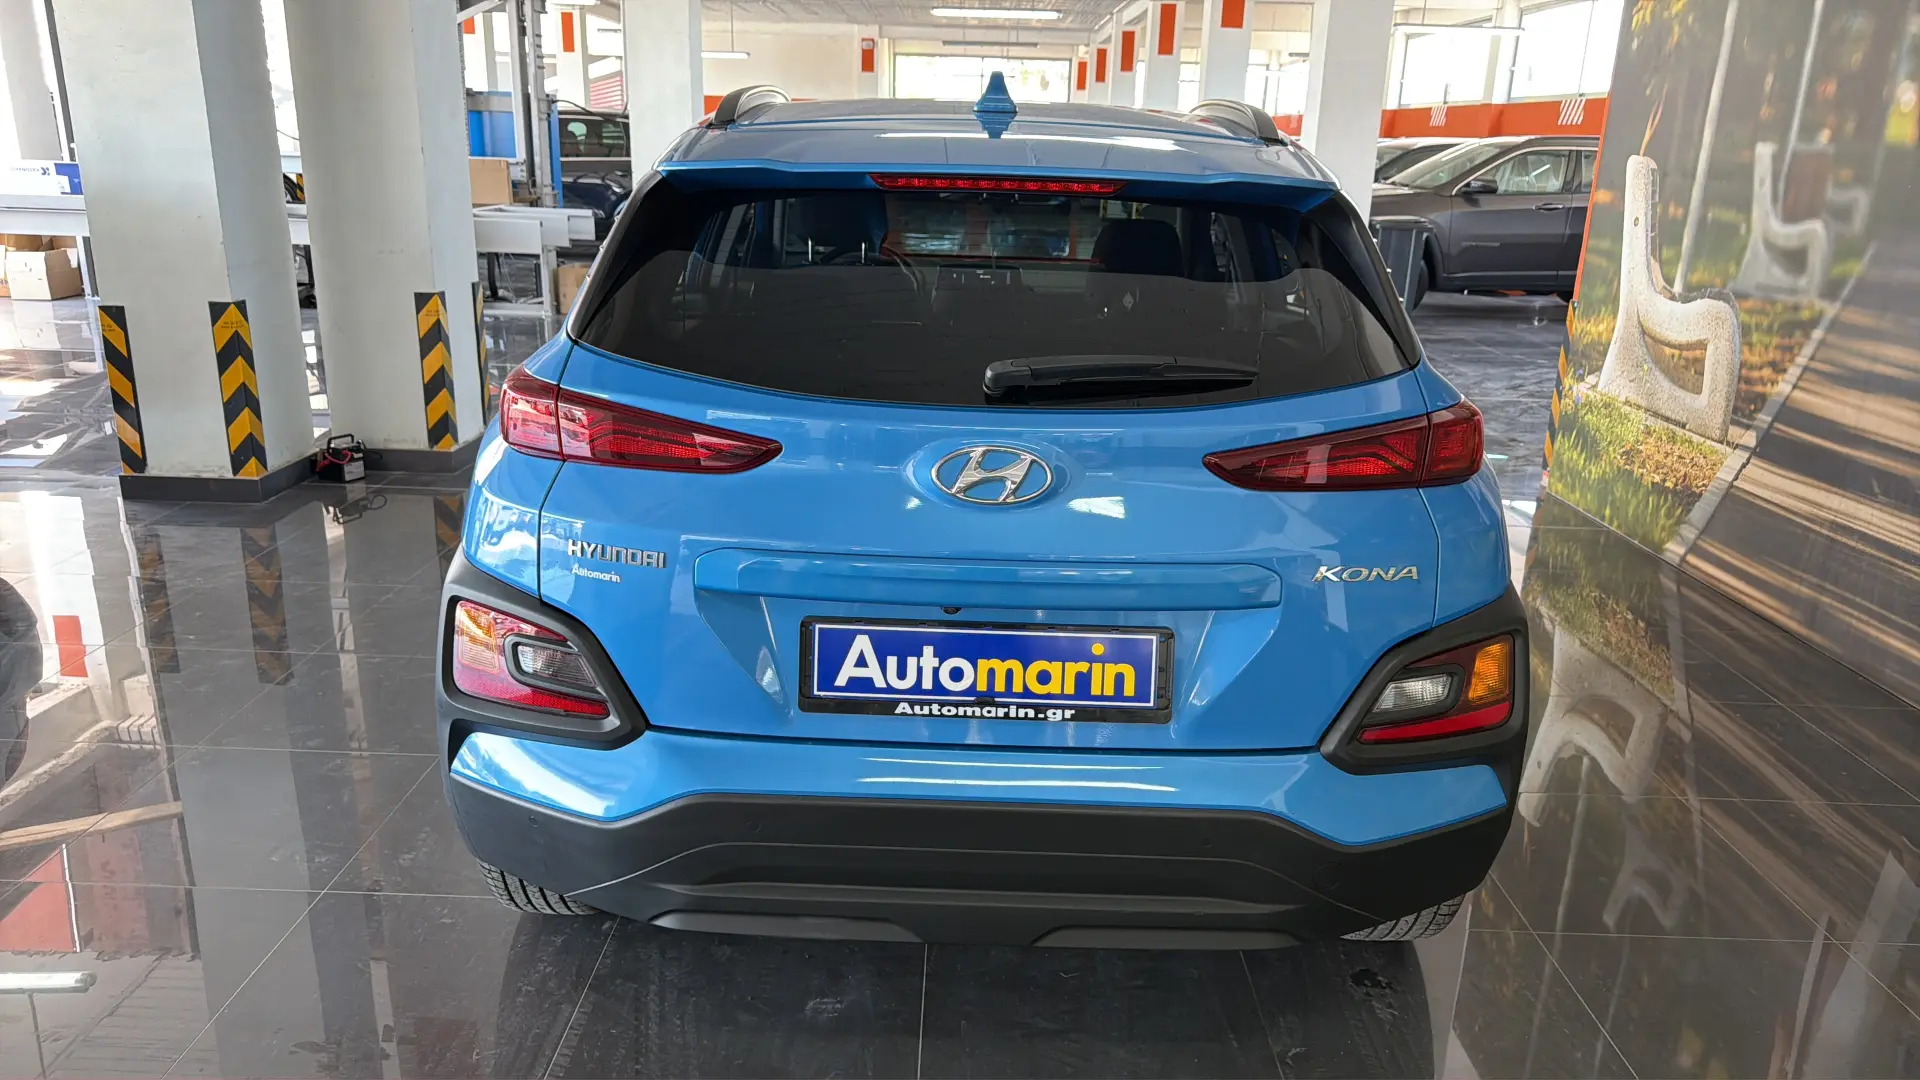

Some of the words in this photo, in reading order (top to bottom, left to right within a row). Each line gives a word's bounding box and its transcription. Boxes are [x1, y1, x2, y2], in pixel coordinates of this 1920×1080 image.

[568, 539, 666, 568] HYUNDAI
[572, 564, 621, 583] Automarin
[1311, 565, 1420, 582] KONA
[833, 633, 1136, 698] Automarin
[894, 702, 1076, 722] Automarin.gr
